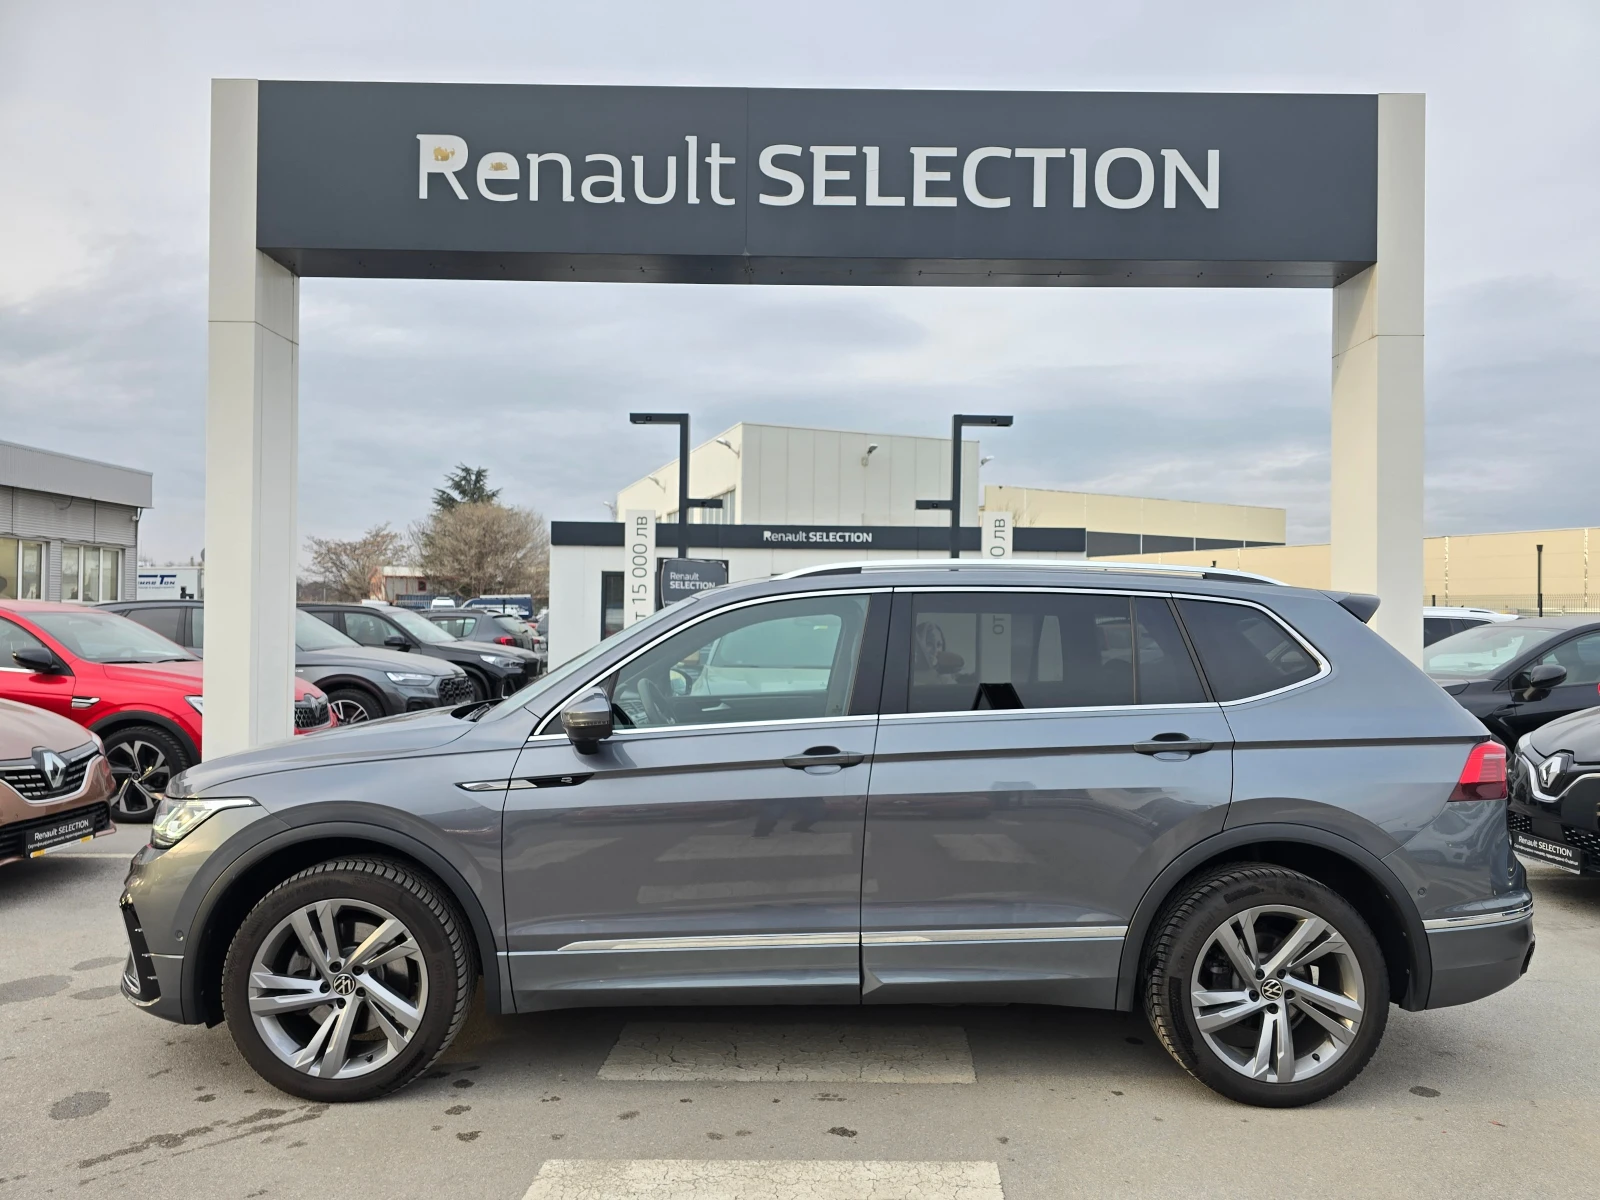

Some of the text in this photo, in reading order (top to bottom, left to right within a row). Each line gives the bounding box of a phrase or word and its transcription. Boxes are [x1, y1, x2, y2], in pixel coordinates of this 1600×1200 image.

[416, 133, 1220, 210] Renault SELECTION
[763, 530, 873, 543] Renault SELECTION
[632, 543, 648, 578] 000
[669, 572, 699, 581] Renault
[669, 581, 716, 590] SELECTION
[632, 584, 647, 604] 15
[34, 828, 58, 841] Renault
[58, 819, 90, 835] SELECTION
[1518, 835, 1538, 848] Renault
[1538, 841, 1573, 858] SELECTION
